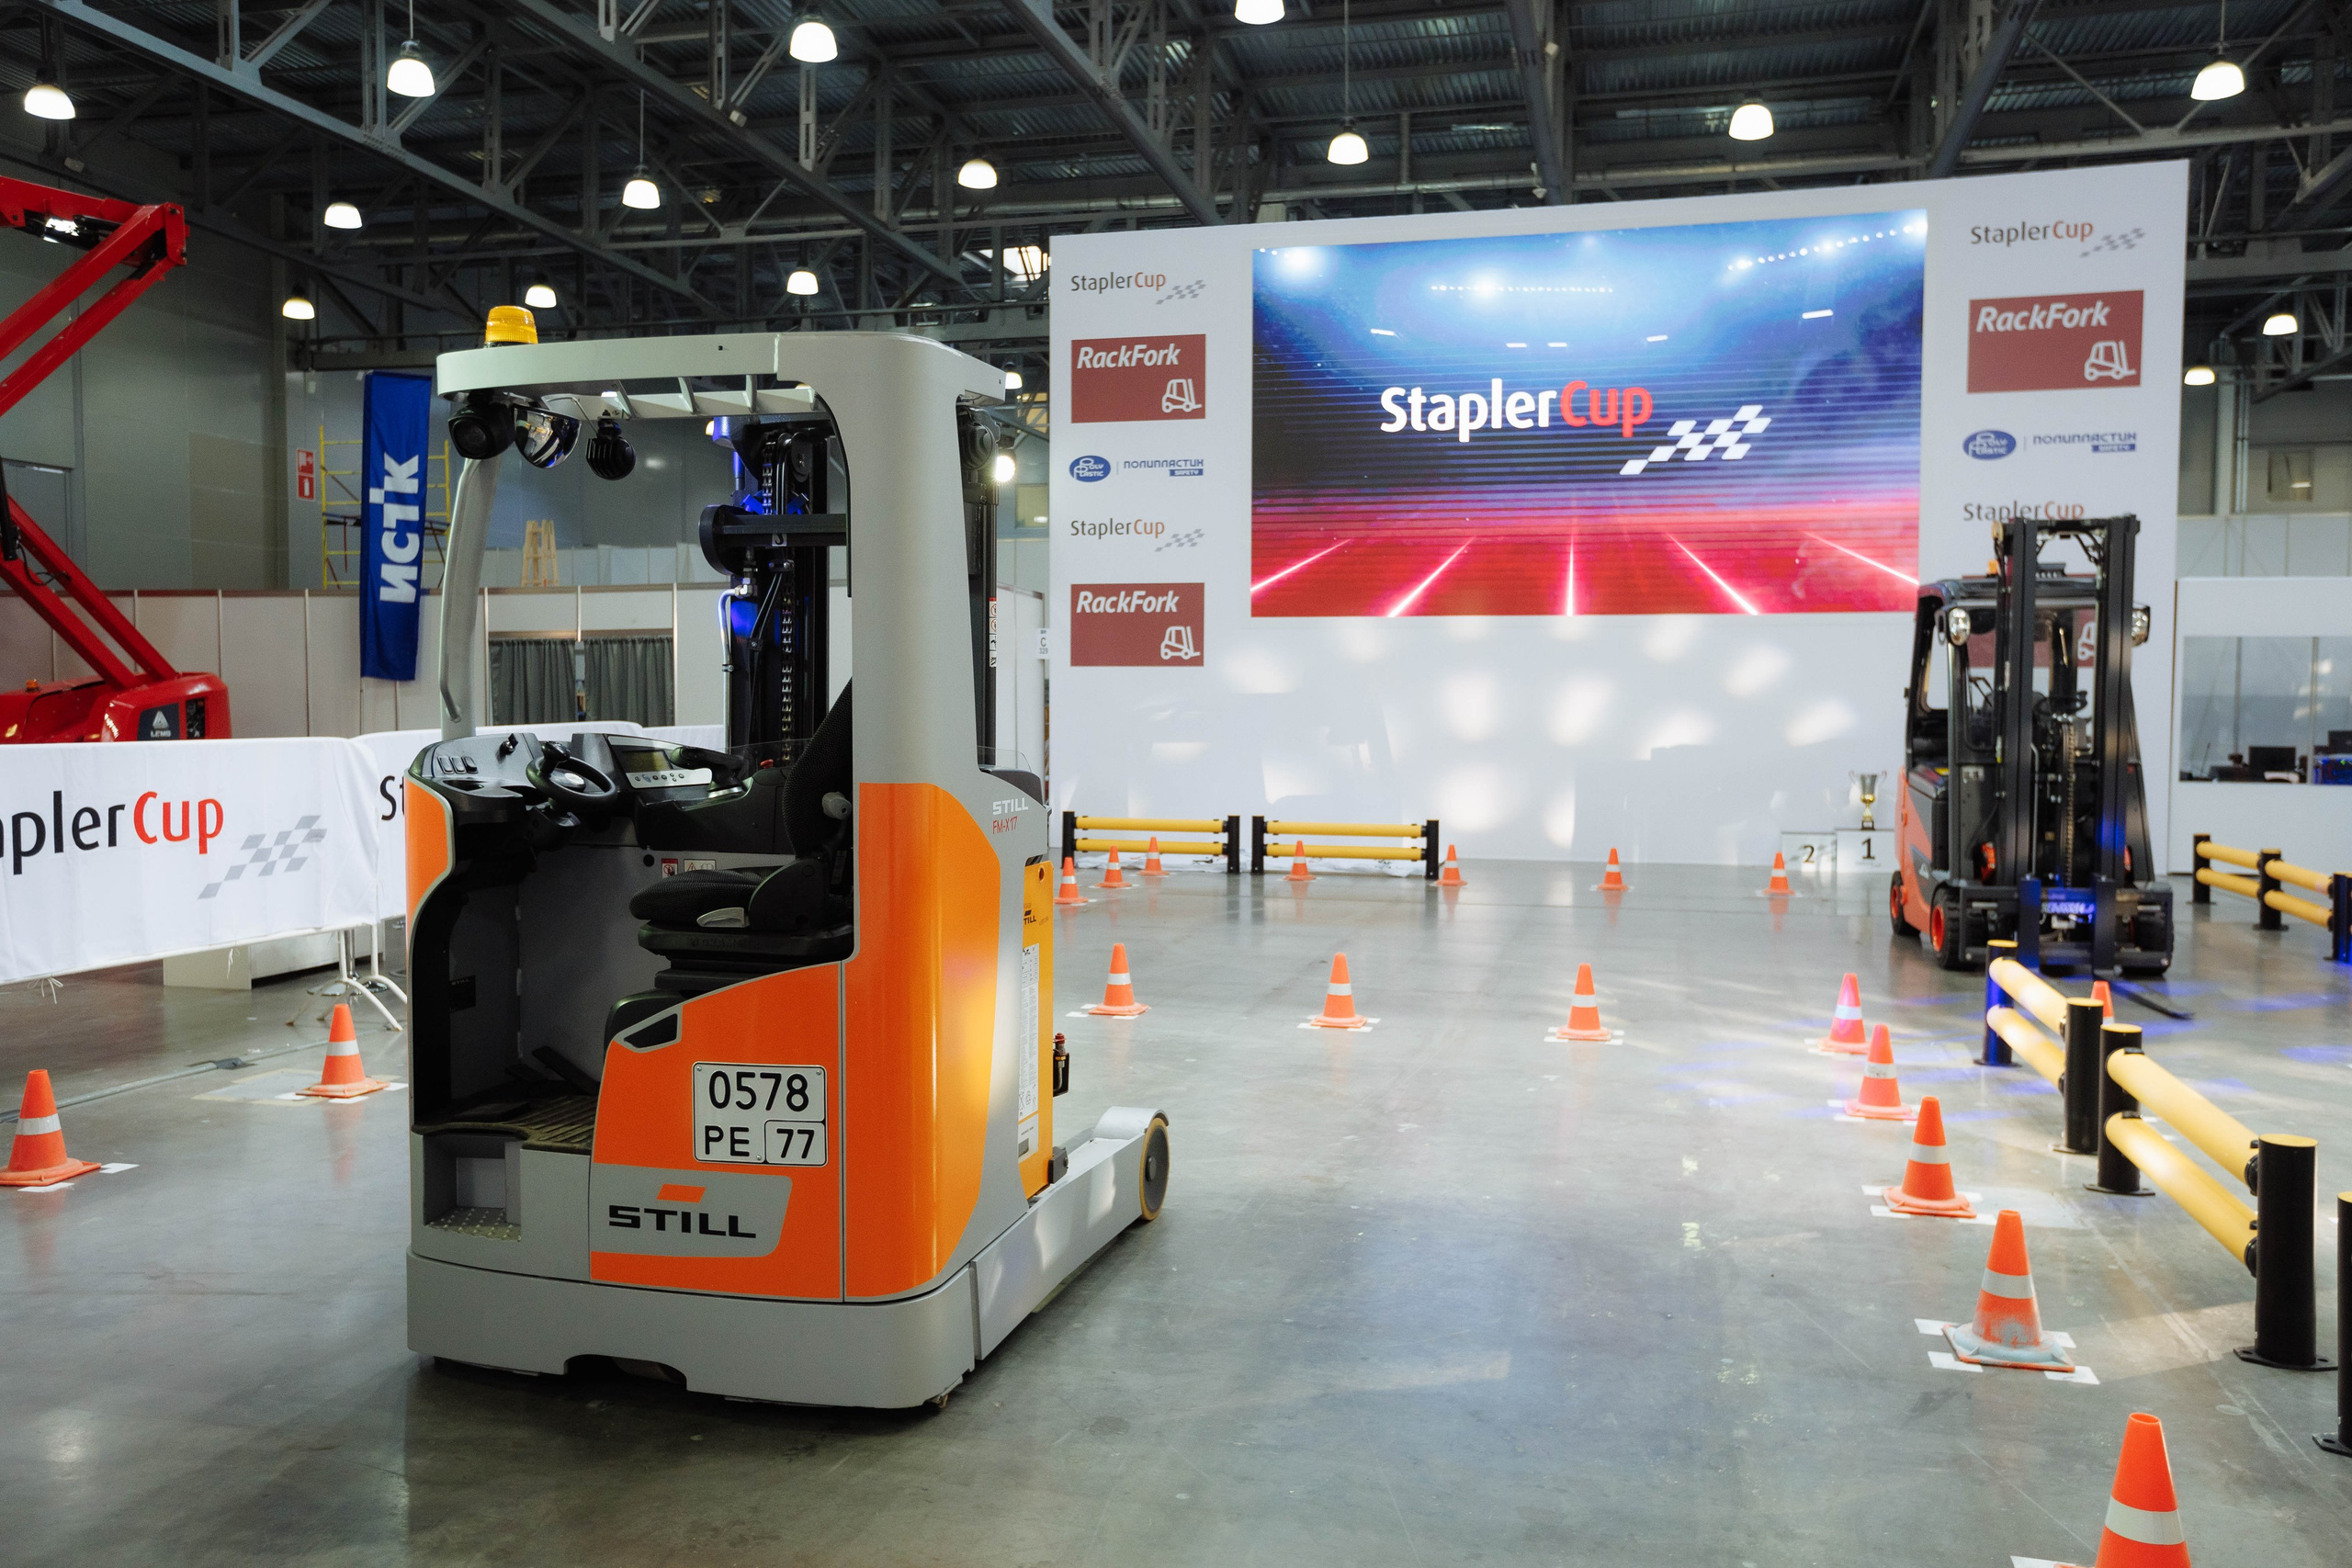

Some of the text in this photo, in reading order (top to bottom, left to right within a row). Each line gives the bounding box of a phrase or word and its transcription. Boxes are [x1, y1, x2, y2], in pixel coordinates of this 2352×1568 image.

[1970, 220, 2094, 247] StaplerCup
[1070, 271, 1166, 294] StaplerCup
[1976, 300, 2110, 333] RackFork
[1077, 344, 1182, 368] RackFork
[1380, 378, 1653, 443] StaplerCup
[1070, 518, 1165, 539] StaplerCup
[1076, 591, 1180, 613] RackFork
[993, 797, 1028, 816] STILL
[0, 791, 224, 874] plerCup
[1803, 844, 1815, 863] 2
[1861, 837, 1875, 860] 1
[1023, 915, 1036, 925] TILL
[708, 1070, 809, 1111] 0578
[776, 1128, 815, 1159] 77
[609, 1204, 756, 1238] STILL
